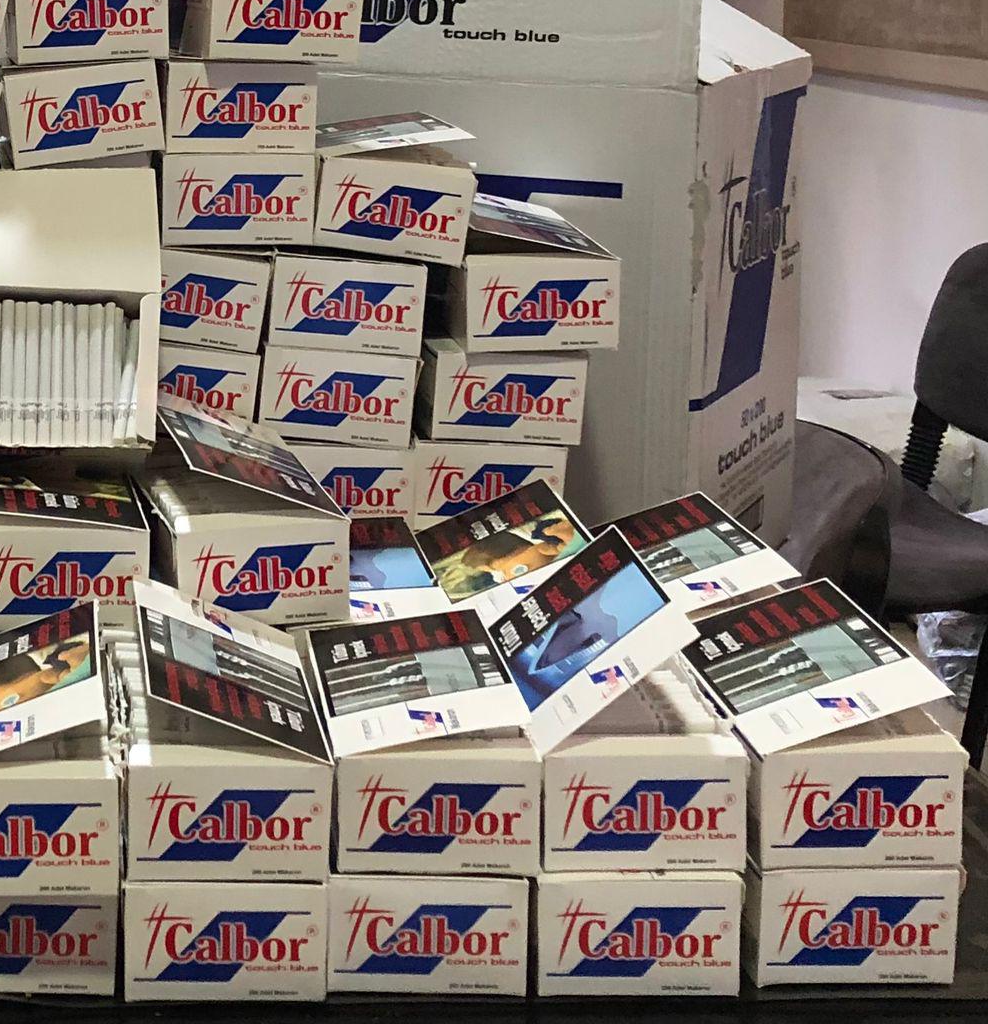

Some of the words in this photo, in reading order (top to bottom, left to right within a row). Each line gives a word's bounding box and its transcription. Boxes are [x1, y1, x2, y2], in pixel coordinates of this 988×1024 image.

[443, 28, 506, 41] touch
[514, 30, 560, 43] blue
[37, 94, 146, 132] Calbor
[196, 92, 303, 122] Calbor
[192, 184, 300, 214] Calbor
[348, 190, 456, 232] Calbor
[162, 282, 251, 322] albor
[301, 287, 410, 323] Calbor
[497, 289, 606, 321] Calbor
[158, 374, 242, 410] lbor
[290, 378, 399, 416] Calbor
[463, 382, 571, 414] Calbor
[718, 429, 757, 475] touch
[759, 411, 784, 443] blue
[324, 476, 401, 507] lbor
[442, 471, 513, 502] Calb
[9, 563, 133, 597] Calbor
[212, 556, 334, 594] Calbor
[168, 802, 312, 841] Calbor
[378, 795, 521, 835] Calbor
[582, 792, 726, 831] Calbor
[803, 789, 945, 828] Calbor
[164, 924, 308, 962] Calbor
[366, 916, 509, 955] Calbor
[578, 919, 722, 957] Calbor
[799, 909, 939, 946] Calbor
